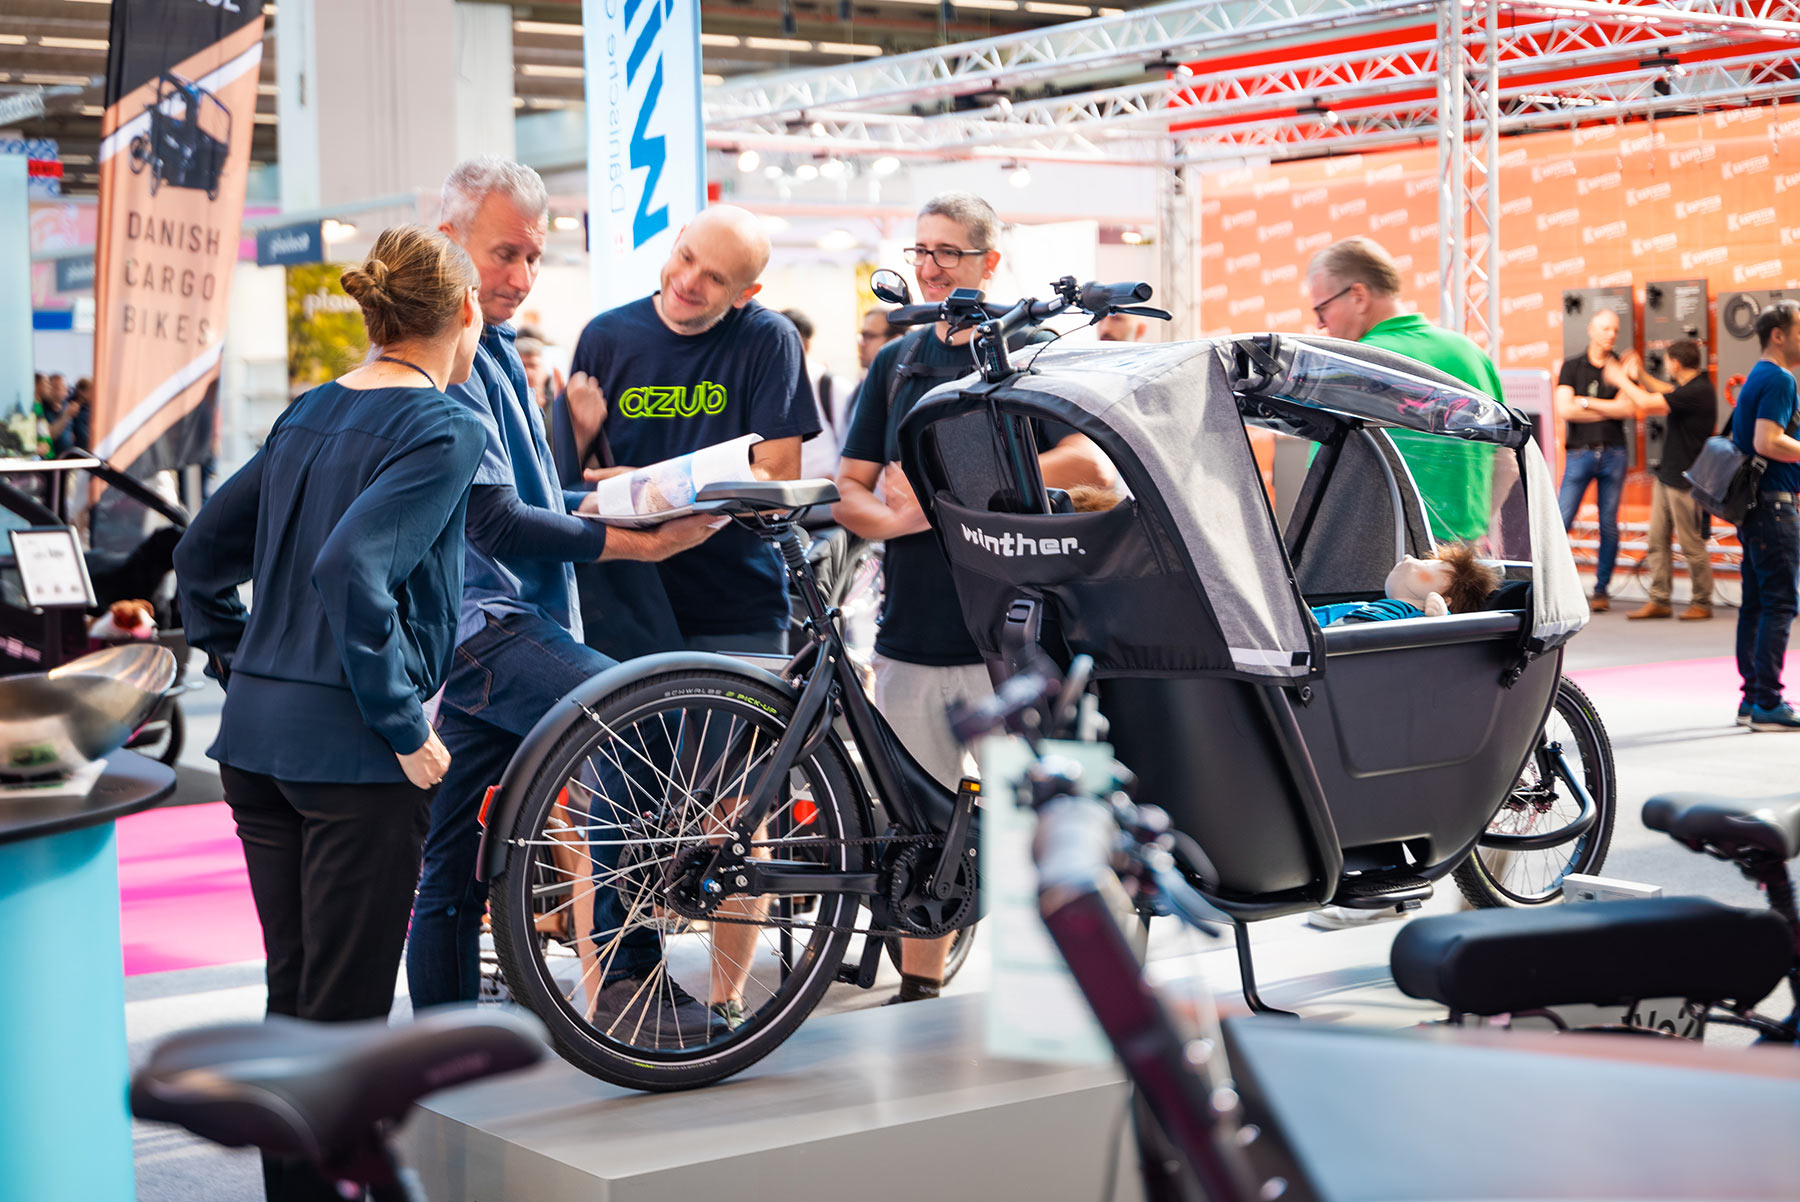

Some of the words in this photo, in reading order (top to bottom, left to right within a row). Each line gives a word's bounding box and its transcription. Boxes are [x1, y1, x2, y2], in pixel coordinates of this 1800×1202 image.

[127, 210, 220, 255] DANISH
[124, 257, 216, 301] CARGO
[122, 304, 210, 346] BIKES
[619, 381, 727, 418] azub
[960, 522, 1087, 557] winther.
[664, 688, 722, 697] SCHWALBE
[736, 693, 778, 715] PICK-UP
